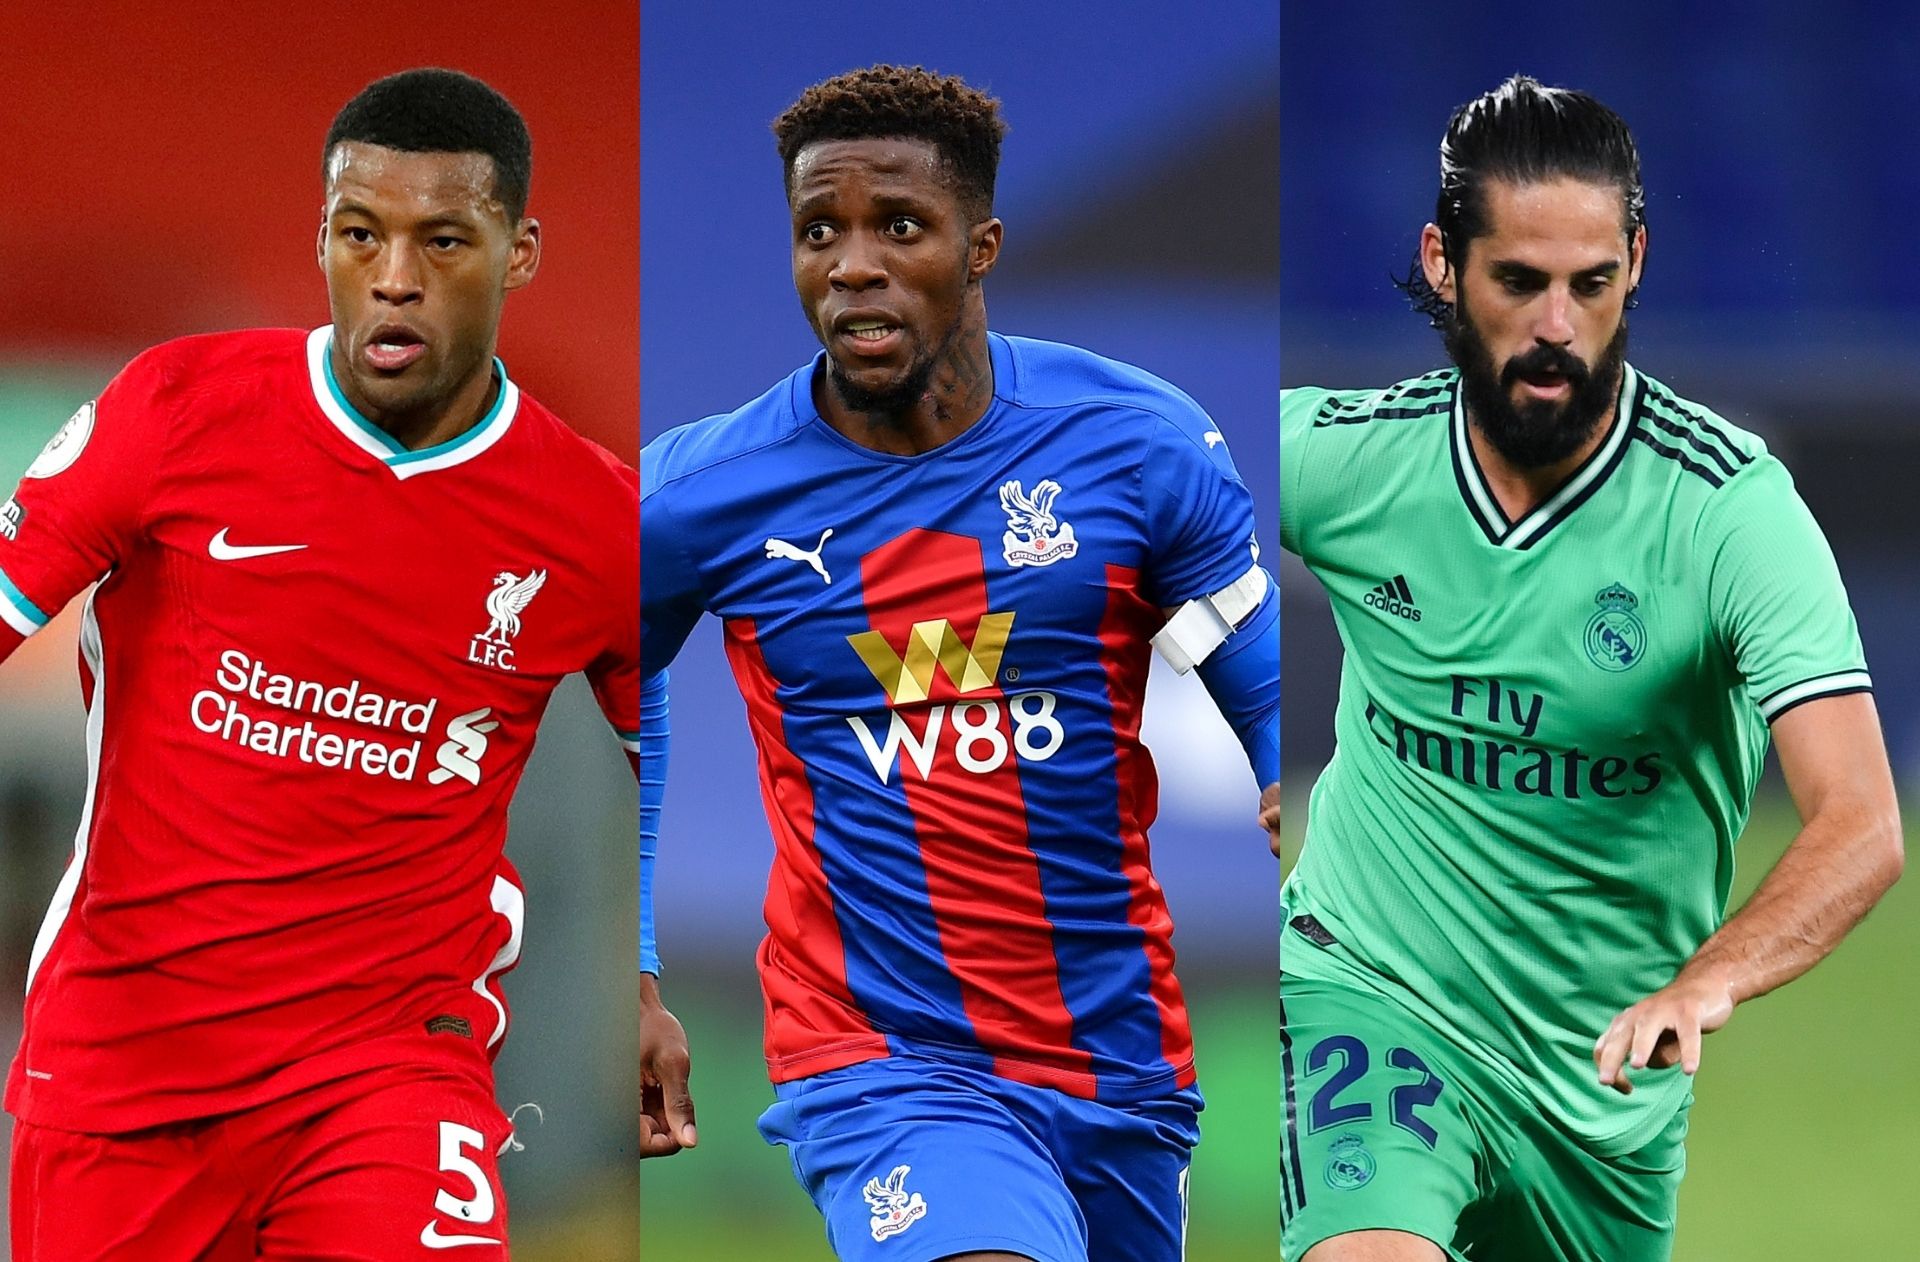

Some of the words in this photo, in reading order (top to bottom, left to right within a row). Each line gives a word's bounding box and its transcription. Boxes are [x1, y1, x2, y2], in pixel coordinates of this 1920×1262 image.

[1364, 592, 1421, 622] adidas
[216, 650, 437, 734] Standard
[468, 640, 516, 671] L.F.C.
[190, 690, 421, 781] Chartered
[846, 691, 1064, 786] W88
[1451, 674, 1543, 737] Fly
[1304, 1034, 1444, 1151] 22
[434, 1121, 495, 1223] 5
